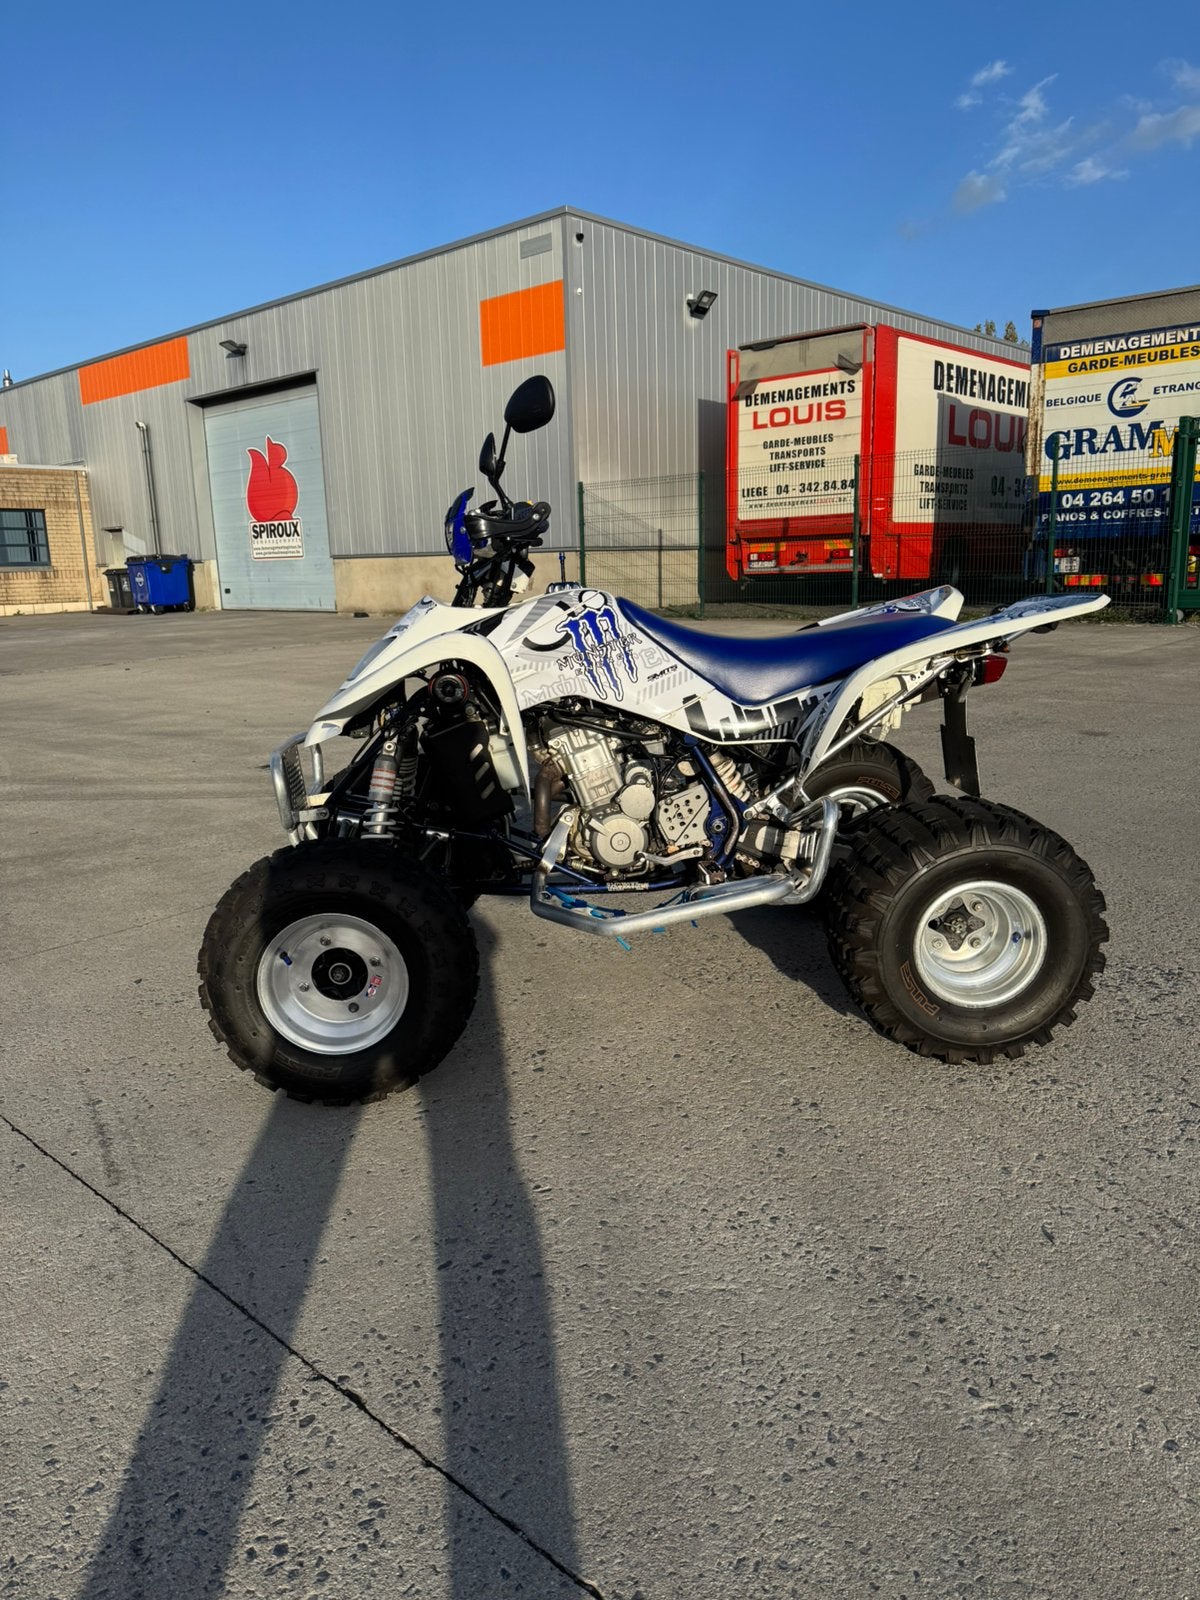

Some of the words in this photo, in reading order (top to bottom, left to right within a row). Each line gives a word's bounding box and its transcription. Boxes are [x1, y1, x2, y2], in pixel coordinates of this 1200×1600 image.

[1059, 327, 1200, 359] DEMENAGEMENT
[1067, 345, 1200, 373] GARDE-MEUBLES
[745, 380, 855, 408] DEMENAGEMENTS
[1046, 393, 1102, 408] BELGIQUE
[752, 399, 847, 430] LOUIS
[762, 433, 834, 449] GARDE-MEUBLES
[769, 446, 826, 460] TRANSPORTS
[769, 459, 826, 473] LIFT-SERVICE
[914, 464, 974, 480] GARDE-MEUBLES
[742, 486, 768, 498] LIEGE
[776, 485, 789, 495] 04
[799, 478, 855, 493] 342.84.84
[920, 481, 968, 495] TRANSPORTS
[991, 475, 1005, 496] 04
[919, 498, 968, 511] LIFT-SERVICE
[1062, 493, 1084, 509] 04
[1090, 490, 1125, 506] 264
[1131, 488, 1155, 503] 50
[1090, 511, 1099, 520] &
[252, 521, 300, 539] SPIROUX
[556, 632, 643, 671] MONSTER
[647, 664, 678, 682] SMITS
